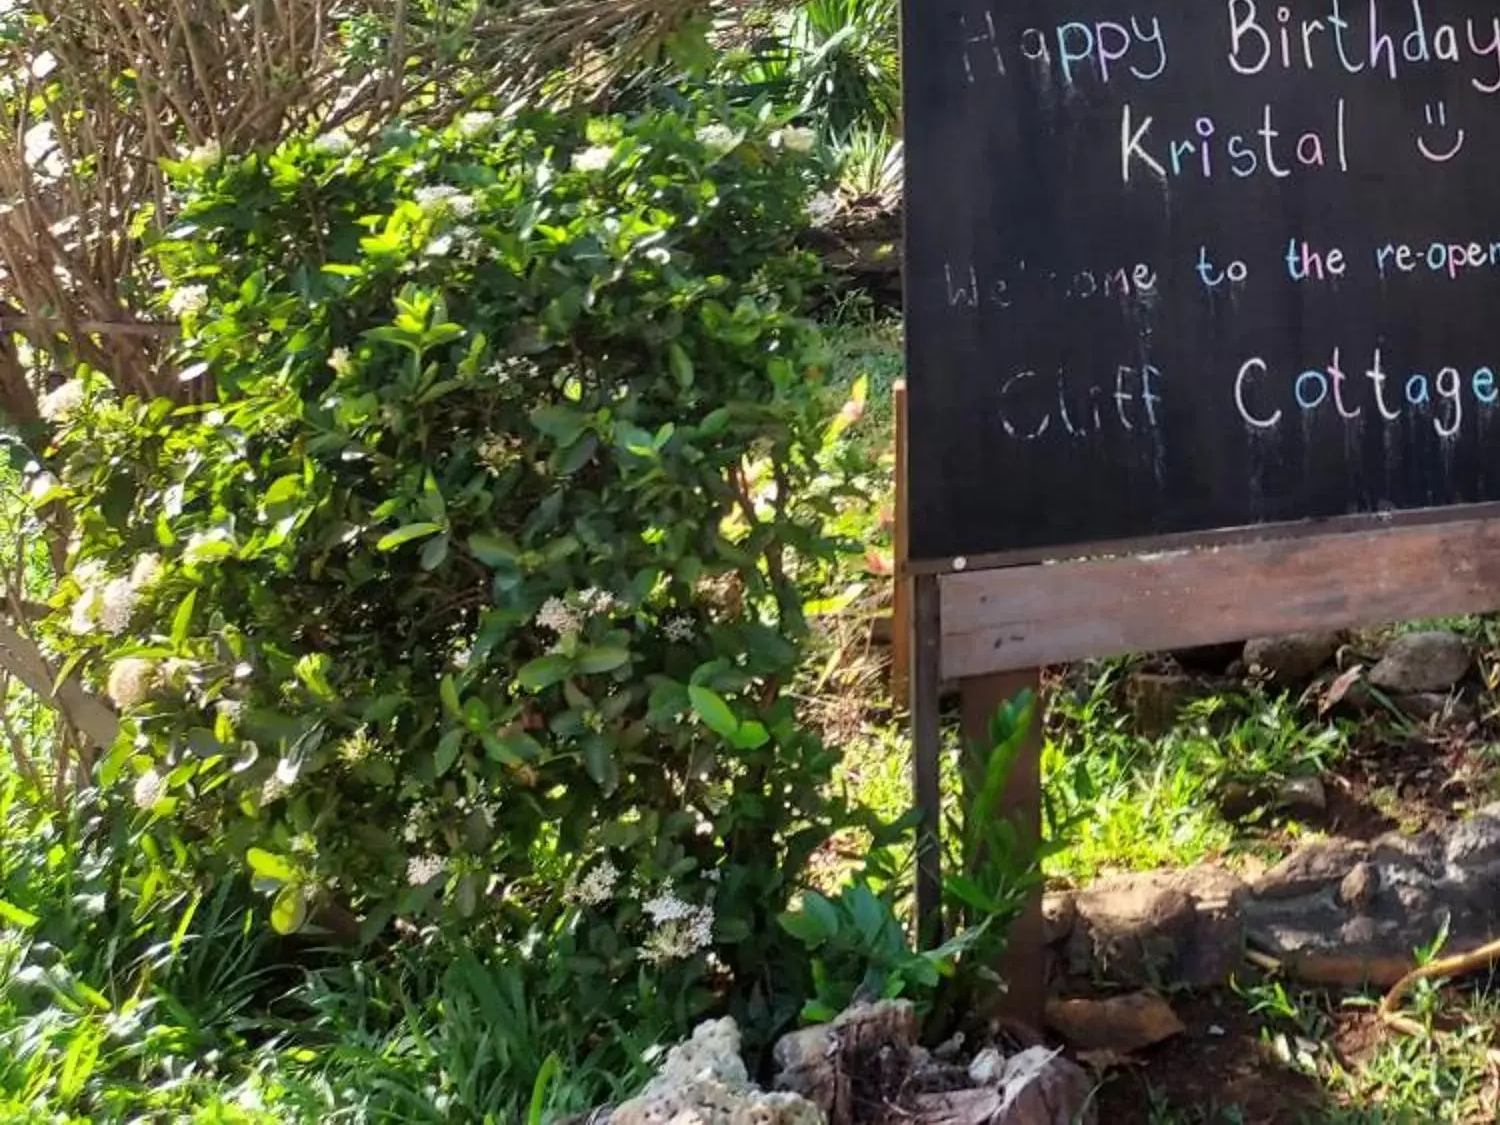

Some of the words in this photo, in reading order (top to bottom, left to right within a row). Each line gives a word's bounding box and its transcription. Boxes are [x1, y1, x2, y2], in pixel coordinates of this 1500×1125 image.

[960, 10, 1167, 83] Happy
[1120, 98, 1348, 183] Kristal
[1198, 247, 1247, 285] to
[1286, 239, 1346, 275] the
[1000, 365, 1161, 438] Cliff
